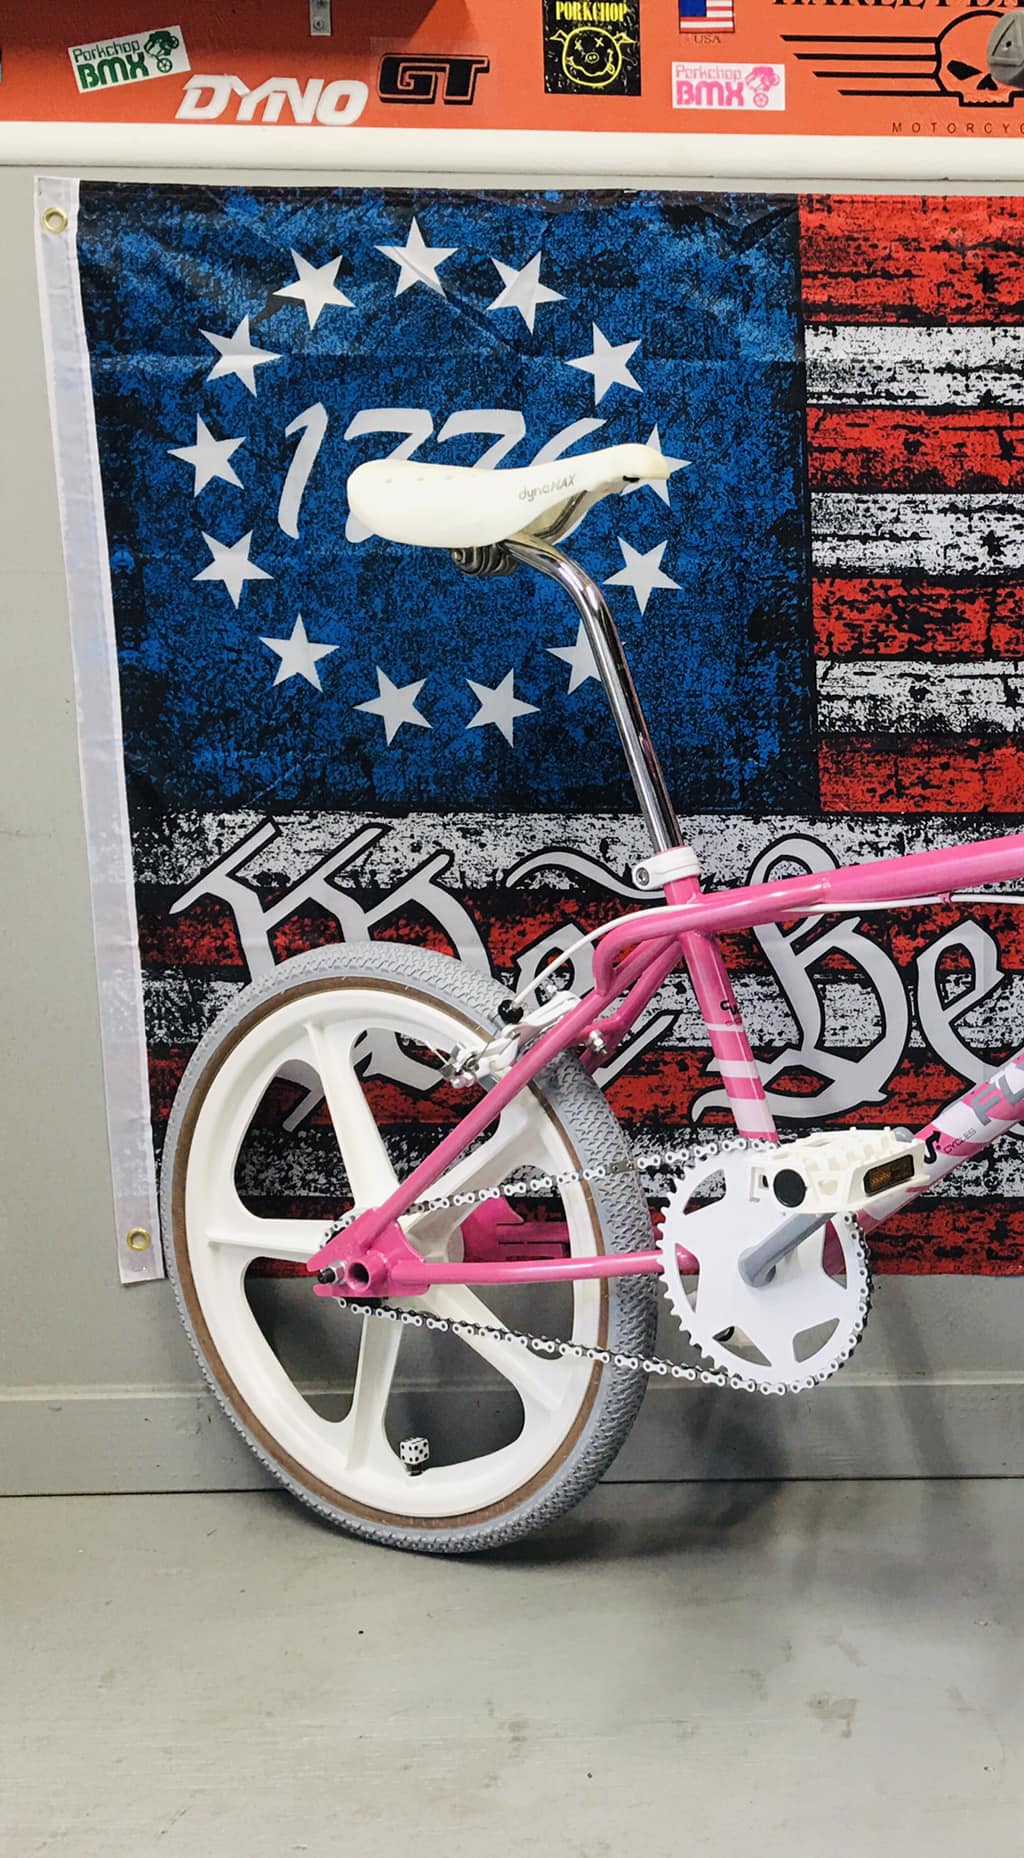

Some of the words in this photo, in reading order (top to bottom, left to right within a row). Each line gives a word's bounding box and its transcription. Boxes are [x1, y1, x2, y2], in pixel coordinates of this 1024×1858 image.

[556, 1, 627, 21] PORKCHOP
[72, 40, 140, 63] Porkchop
[694, 35, 722, 44] USA
[77, 52, 150, 89] BMX
[378, 53, 490, 105] GT
[675, 64, 742, 81] Porkchop
[175, 74, 369, 125] DYNO
[676, 80, 745, 106] BMX
[278, 402, 608, 543] 177
